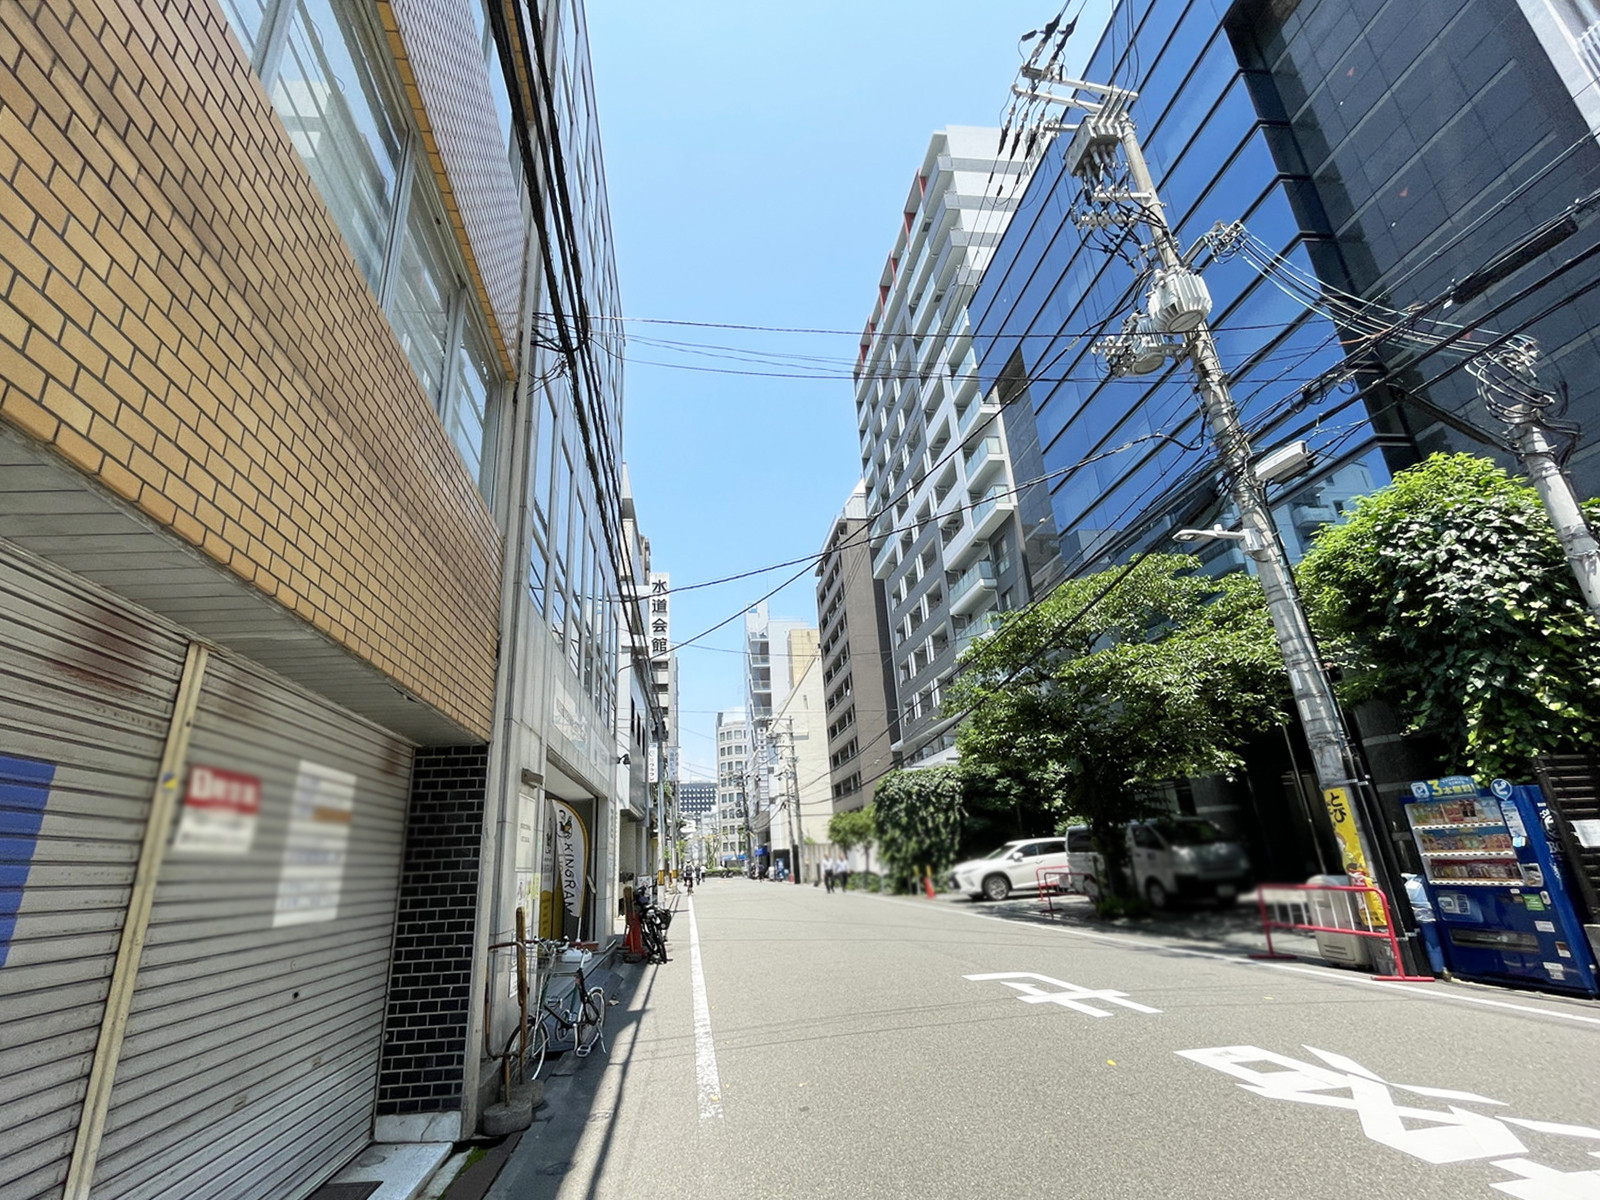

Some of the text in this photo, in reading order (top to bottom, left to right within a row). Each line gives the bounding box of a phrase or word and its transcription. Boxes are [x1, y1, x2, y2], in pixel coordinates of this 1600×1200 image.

[651, 579, 668, 653] 水道会館
[563, 842, 577, 913] KINGRAM
